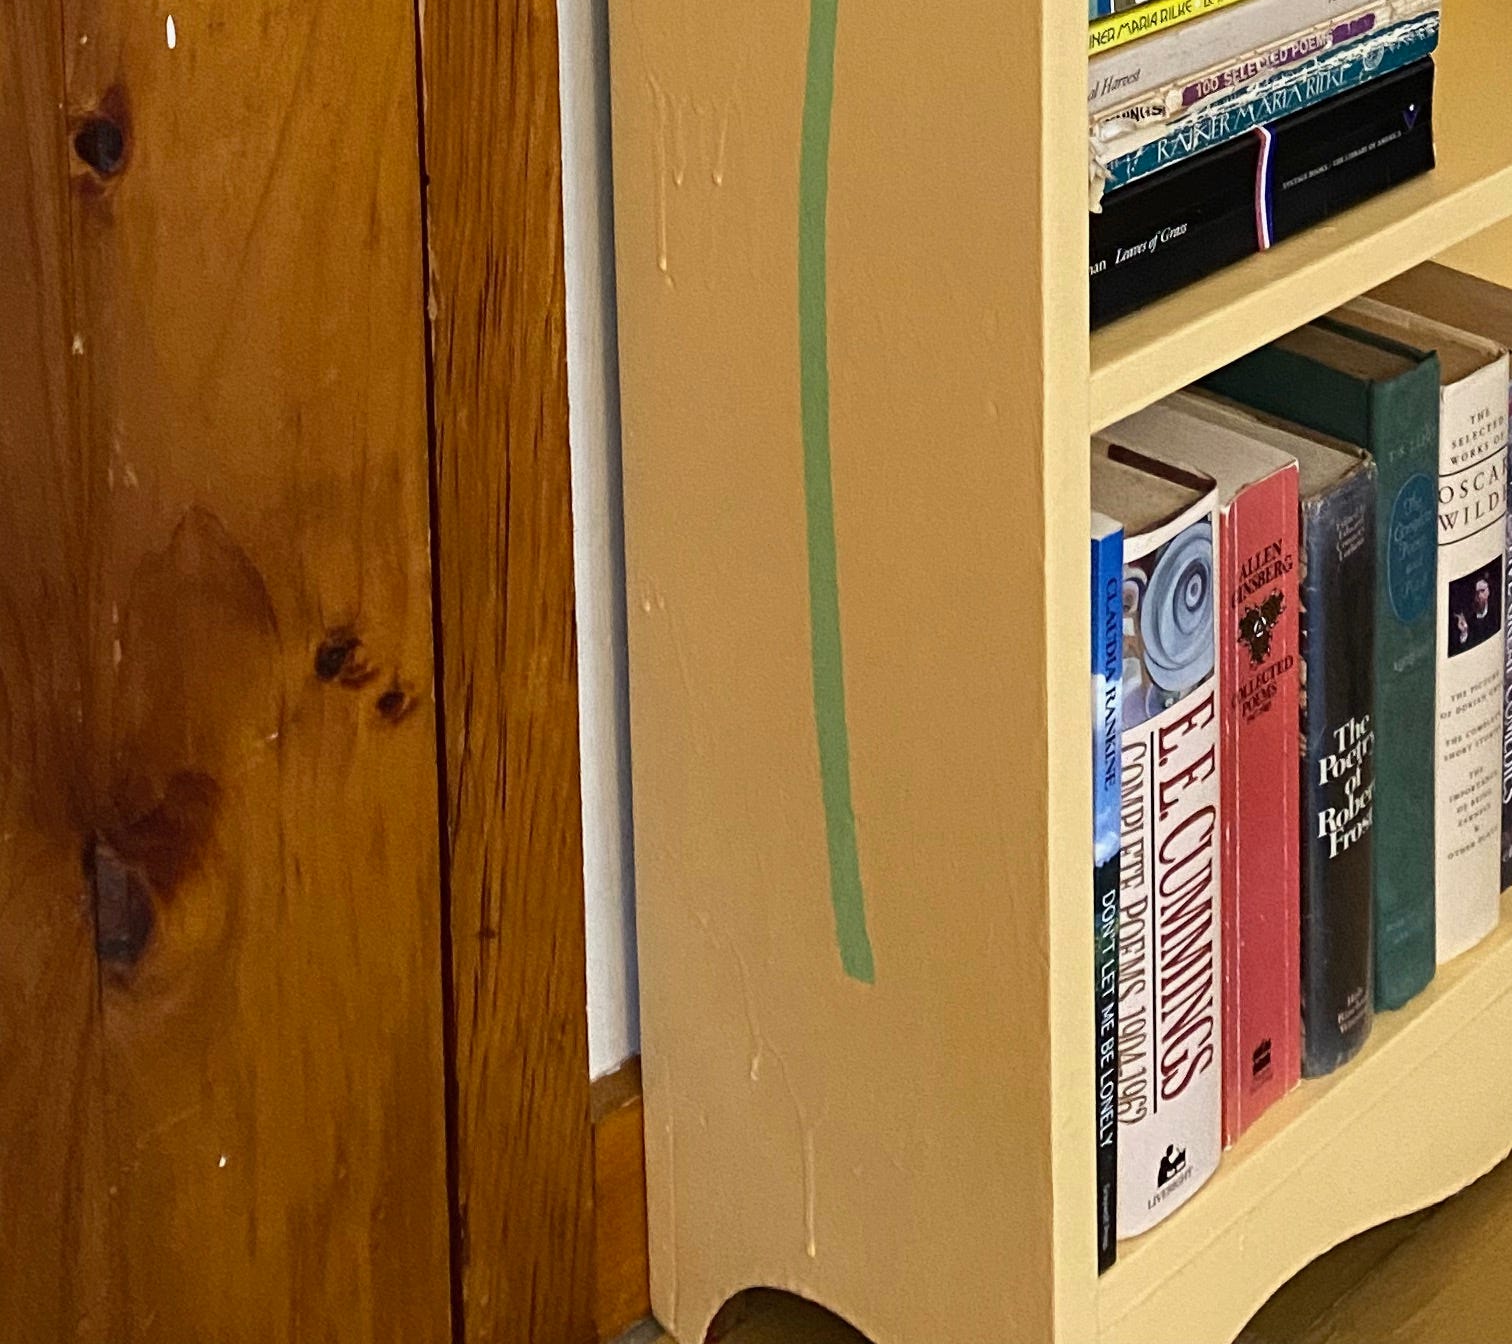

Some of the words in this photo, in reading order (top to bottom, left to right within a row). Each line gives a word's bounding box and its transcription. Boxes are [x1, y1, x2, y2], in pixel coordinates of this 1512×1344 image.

[1101, 69, 1142, 97] Harvest
[1115, 241, 1147, 264] Leaves
[1148, 230, 1161, 253] of
[1161, 223, 1188, 243] Grass
[1452, 416, 1504, 449] SELECTED
[1470, 408, 1490, 424] THE
[1450, 444, 1489, 465] WORKS
[1494, 432, 1504, 444] OF
[1240, 538, 1282, 582] ALLEN
[1231, 555, 1293, 608] GINSBERG
[1106, 579, 1119, 682] CLAUDIA
[1231, 656, 1293, 708] COLLECTED
[1242, 682, 1277, 717] POEMS
[1104, 689, 1119, 791] RANKINE
[1159, 692, 1215, 766] E.
[1334, 714, 1370, 753] The
[1318, 732, 1375, 786] Poetry
[1159, 745, 1215, 820] E.
[1346, 768, 1361, 796] of
[1101, 890, 1116, 950] DON'T
[1159, 805, 1216, 1102] CUMMINGS
[1101, 960, 1115, 995] LET
[1101, 1008, 1115, 1037] ME
[1100, 1042, 1114, 1069] BE
[1099, 1074, 1114, 1149] LONELY
